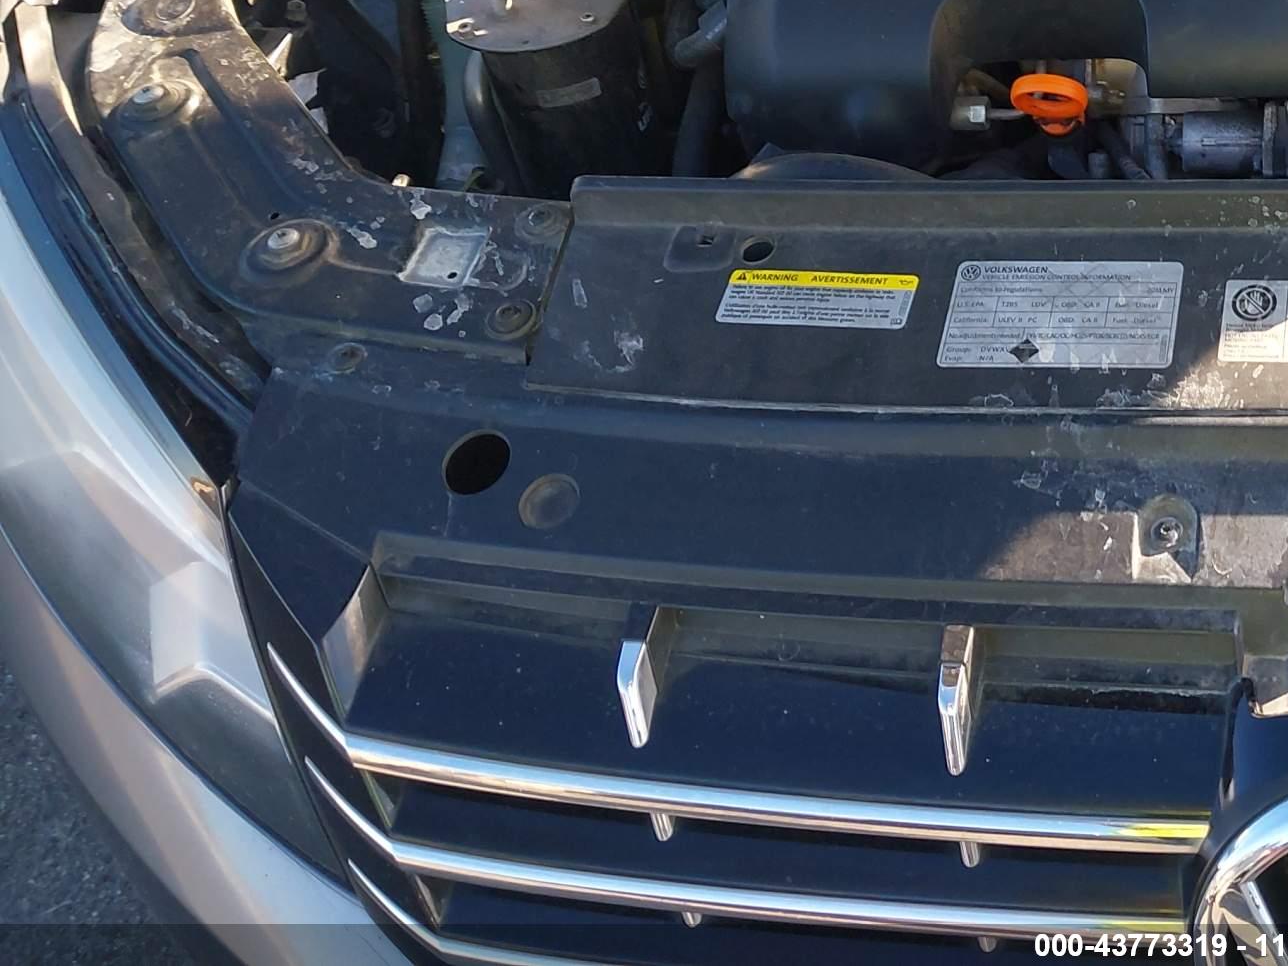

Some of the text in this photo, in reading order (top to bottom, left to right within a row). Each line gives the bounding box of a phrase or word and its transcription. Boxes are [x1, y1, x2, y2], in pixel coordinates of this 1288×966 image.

[984, 265, 1049, 274] VOLKSWAGEN
[751, 273, 888, 285] WARNING AVERTISSEMENT
